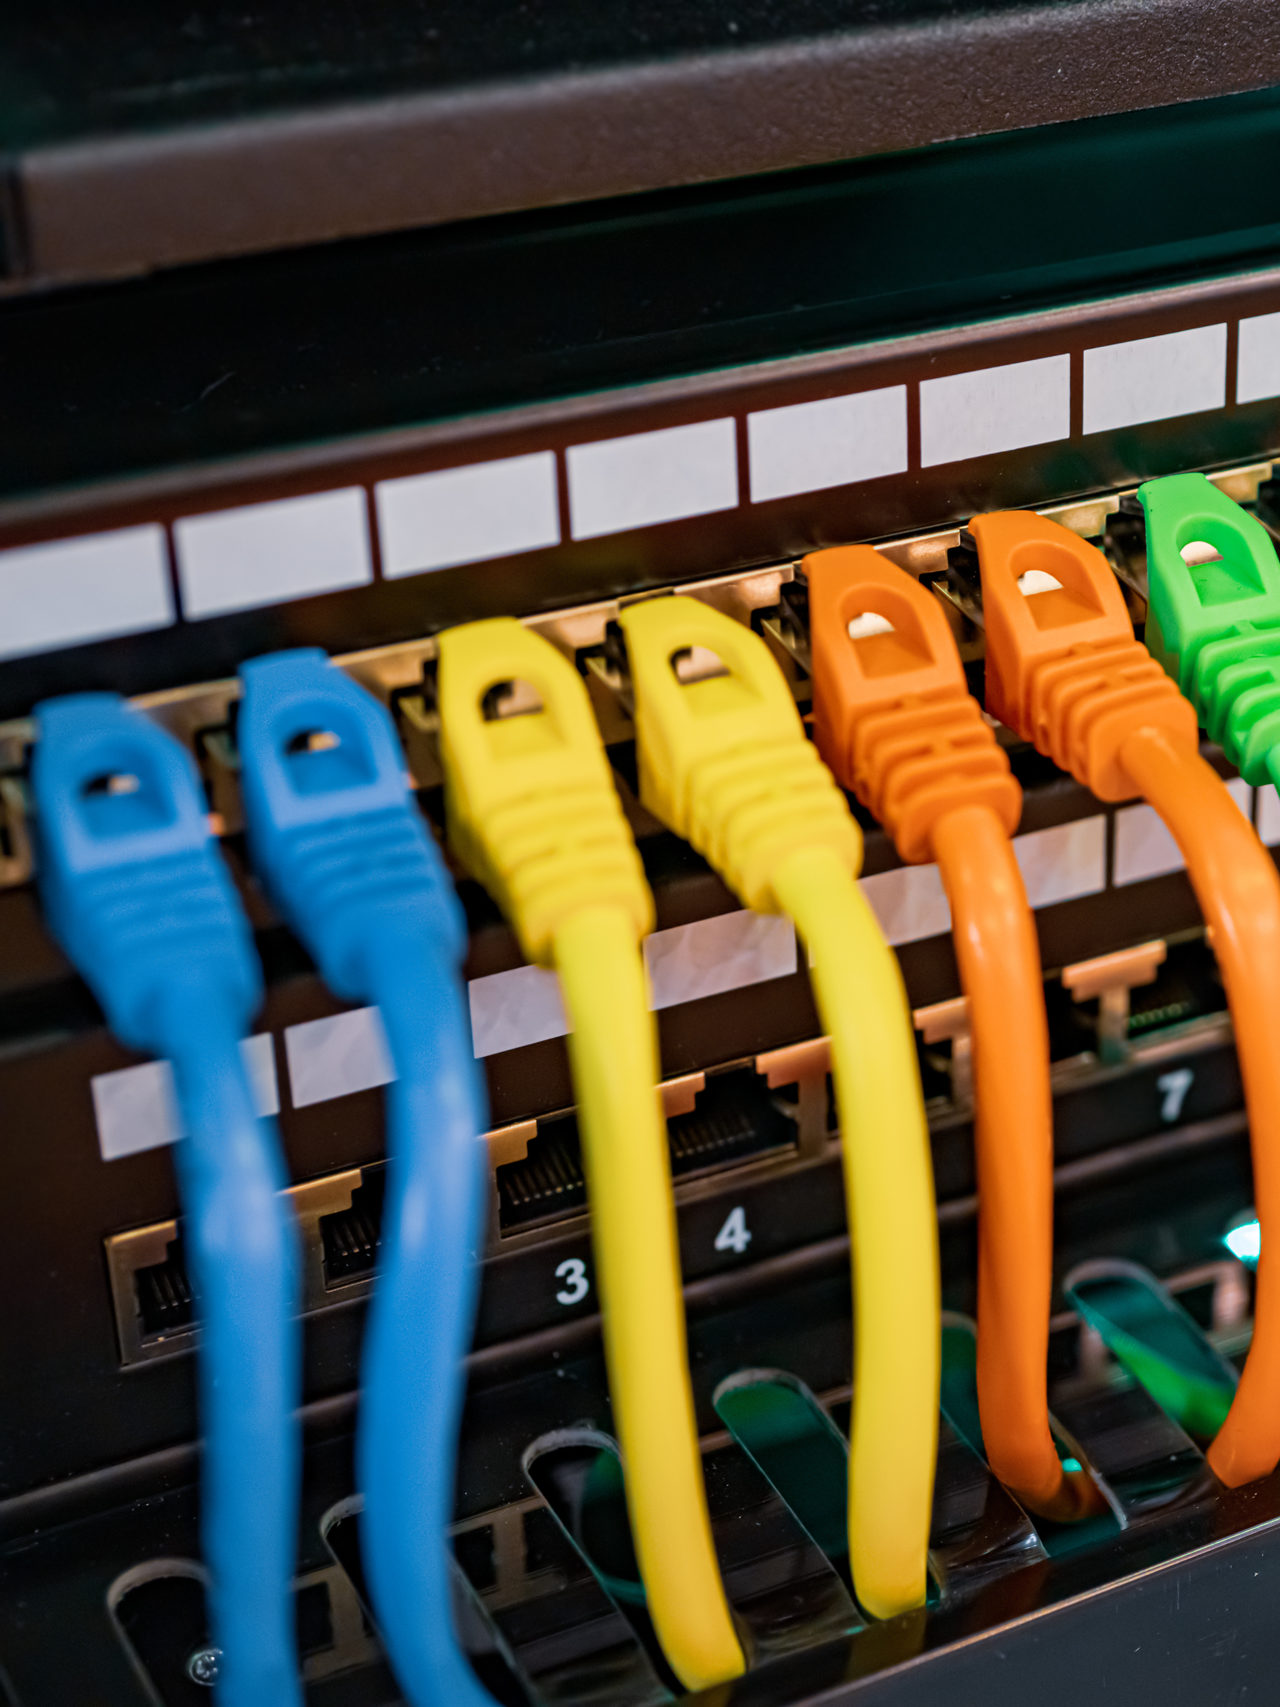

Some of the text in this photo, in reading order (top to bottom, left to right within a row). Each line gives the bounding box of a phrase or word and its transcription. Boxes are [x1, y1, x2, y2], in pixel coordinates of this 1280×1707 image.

[1157, 1068, 1195, 1122] 7
[714, 1206, 752, 1253] 4
[555, 1258, 589, 1305] 3
